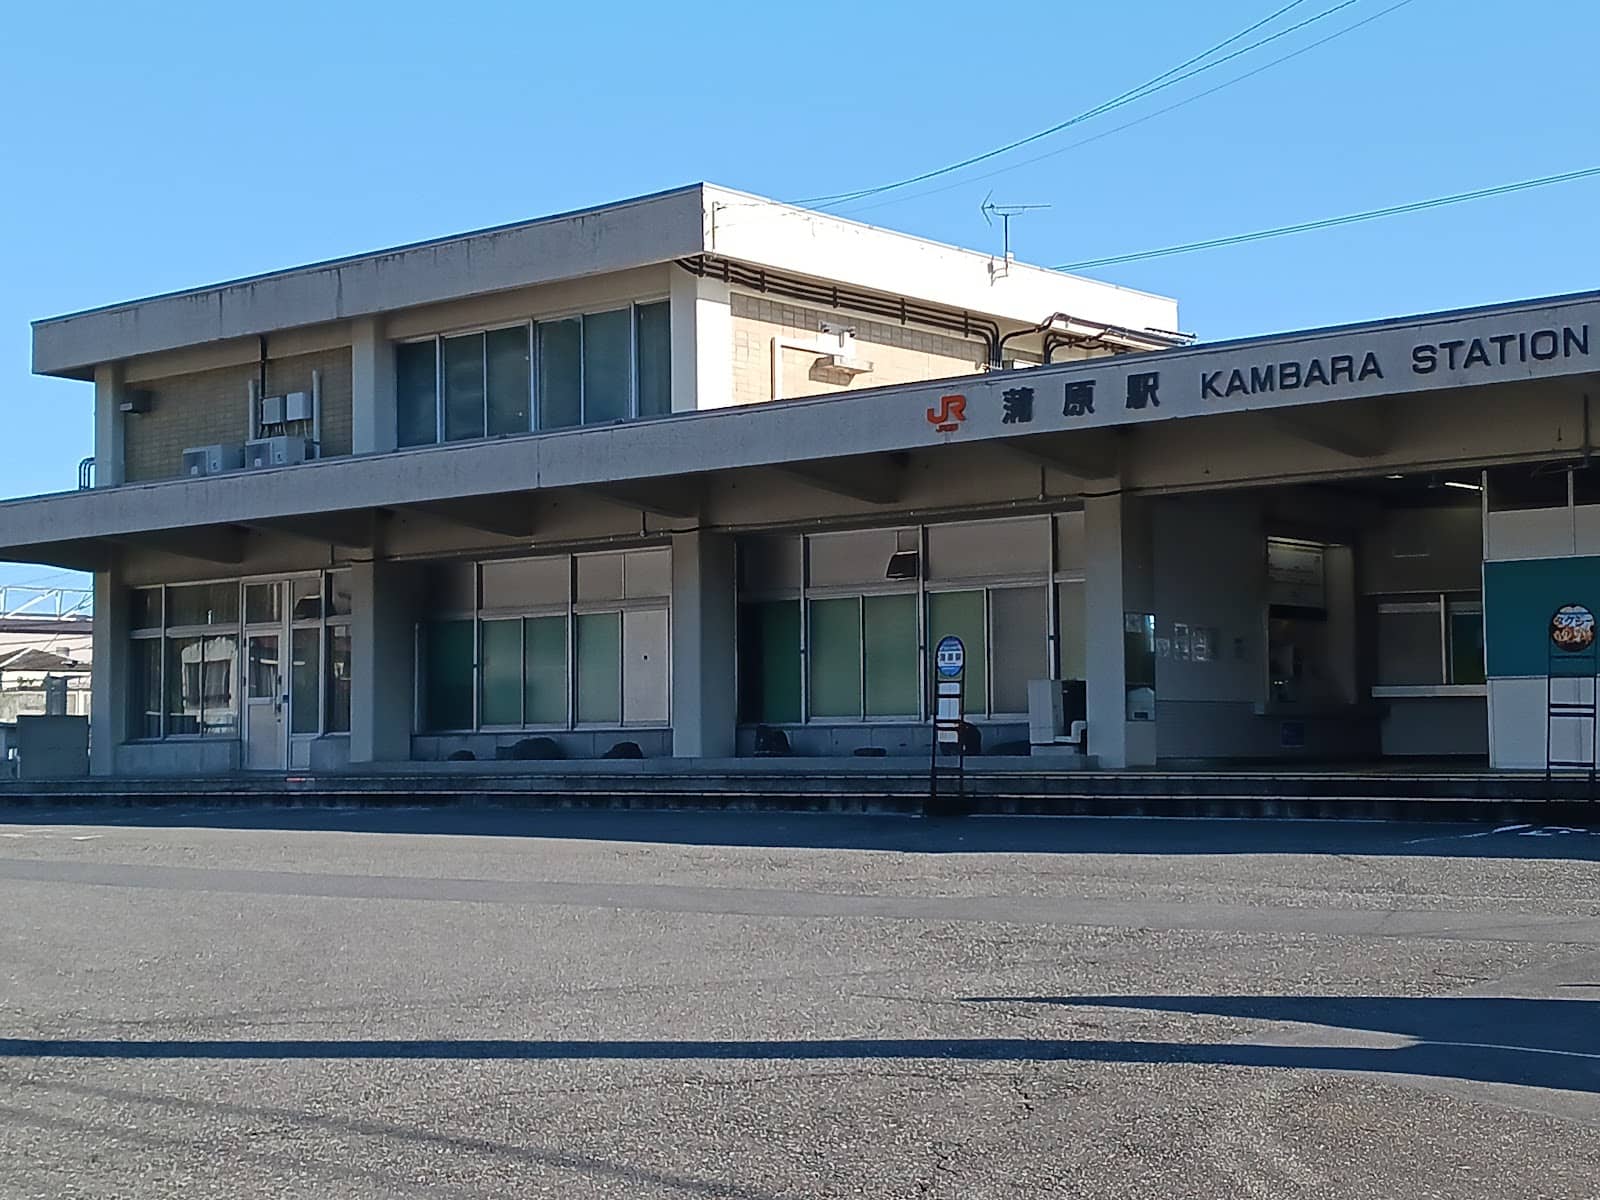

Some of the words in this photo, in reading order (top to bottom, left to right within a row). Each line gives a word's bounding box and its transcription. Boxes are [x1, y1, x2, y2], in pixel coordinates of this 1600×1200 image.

[1201, 352, 1384, 399] KAMBARA
[1412, 324, 1590, 374] STATION
[927, 395, 966, 424] JR
